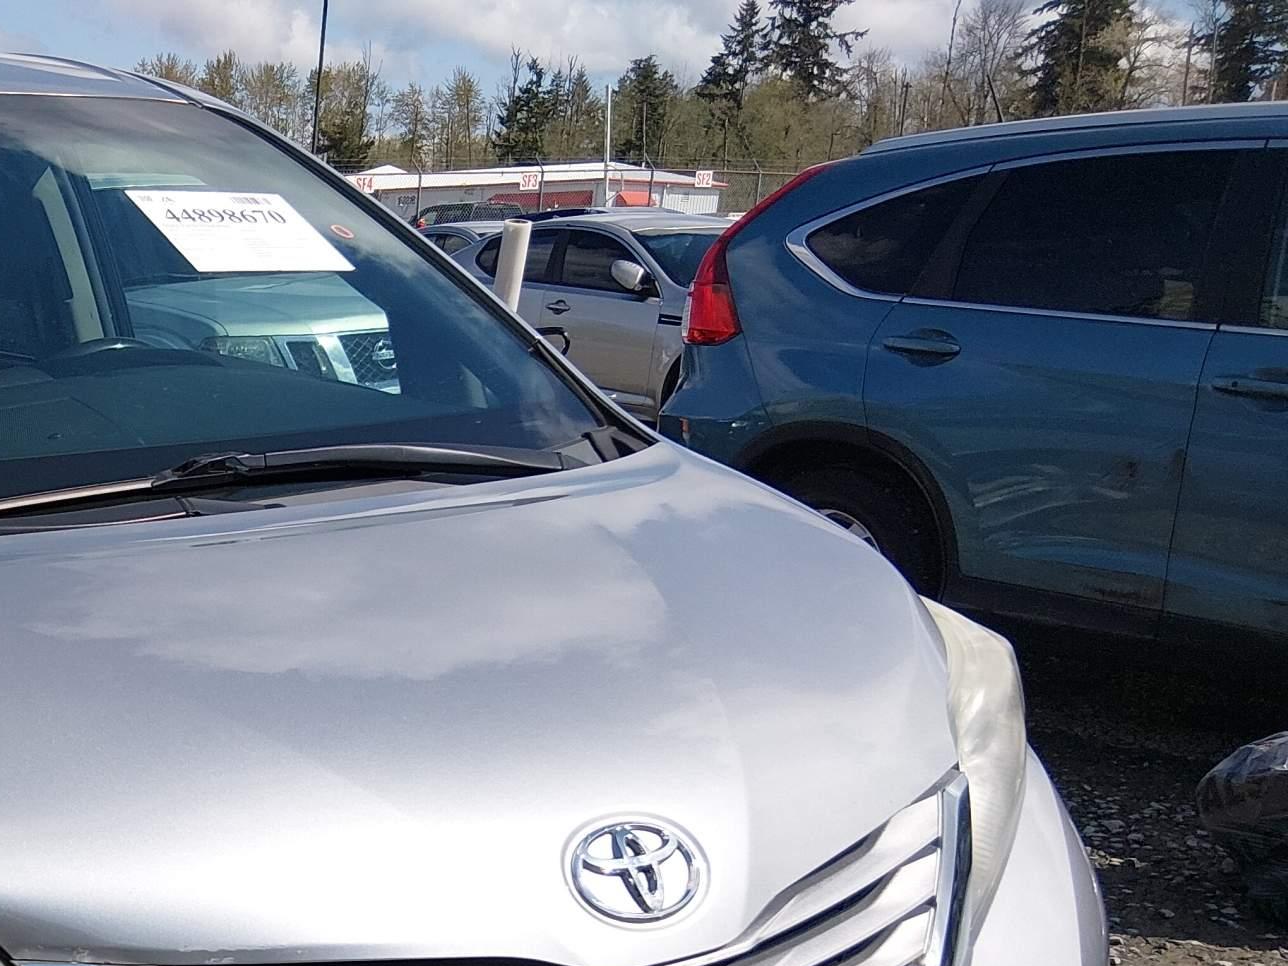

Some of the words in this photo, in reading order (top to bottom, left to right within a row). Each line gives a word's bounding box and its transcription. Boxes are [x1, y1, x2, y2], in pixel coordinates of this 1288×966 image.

[356, 176, 373, 193] SF4
[522, 174, 537, 188] SF3
[697, 172, 711, 185] SF2
[165, 208, 287, 224] 44898670
